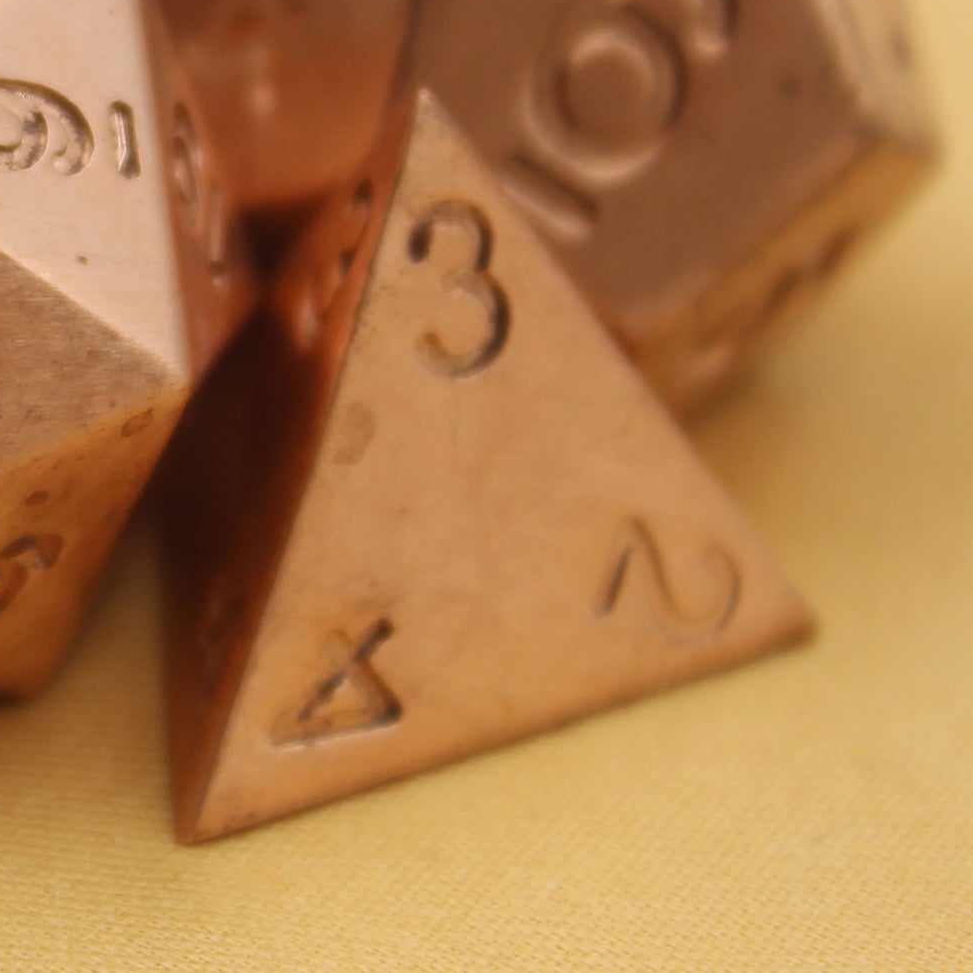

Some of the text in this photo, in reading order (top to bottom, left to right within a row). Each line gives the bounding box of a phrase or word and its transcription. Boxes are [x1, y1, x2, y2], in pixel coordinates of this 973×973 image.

[407, 198, 511, 379] 3
[593, 514, 744, 642] 2
[271, 617, 404, 749] 4
